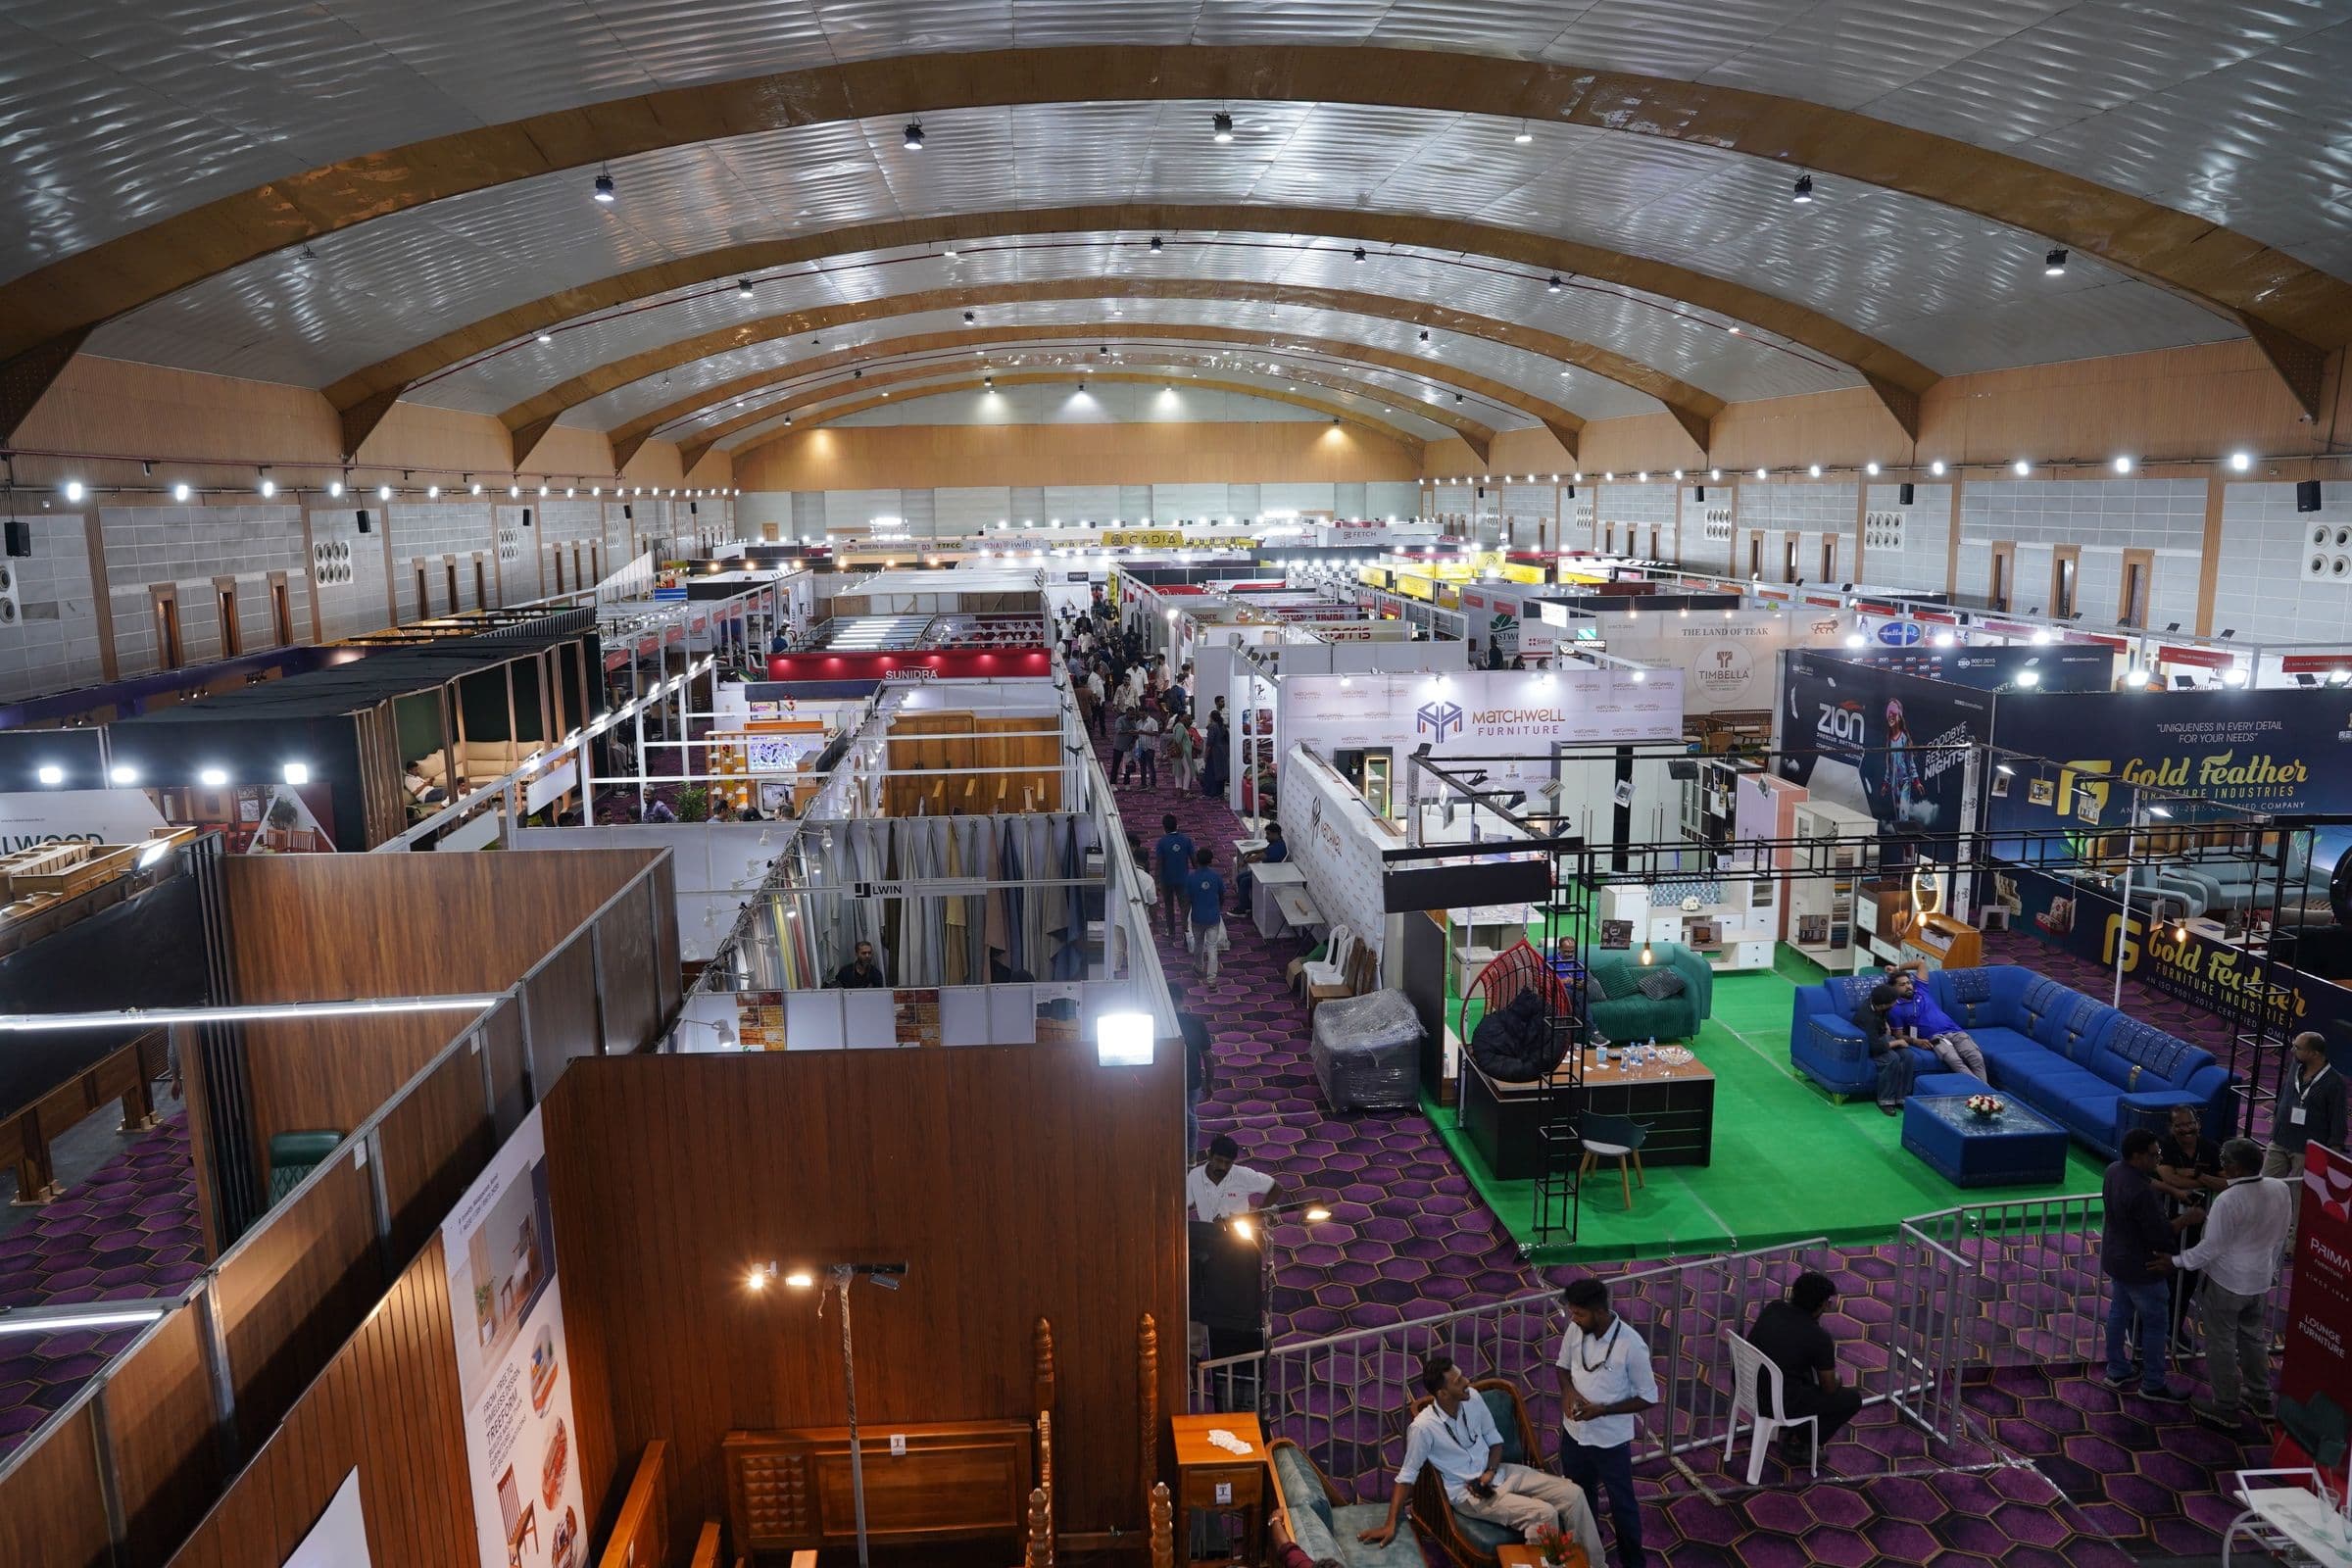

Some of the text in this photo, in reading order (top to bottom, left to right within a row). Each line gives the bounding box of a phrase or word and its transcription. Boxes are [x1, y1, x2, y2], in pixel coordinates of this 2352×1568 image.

[1129, 534, 1176, 544] CADIA
[1682, 628, 1700, 637] THE
[886, 669, 938, 680] SUNIDRA
[1698, 670, 1748, 680] TIMBELLA
[1478, 725, 1559, 736] FURNITURE
[2157, 720, 2282, 733] "UNIQUENESS IN EVERY DETAIL
[2227, 733, 2258, 742] NEEDS"
[1924, 750, 1966, 780] NIGHTS
[2122, 749, 2309, 786] Gold Feather
[2214, 785, 2294, 799] INDUSTRIES
[2260, 801, 2305, 809] COMPANY
[2148, 930, 2203, 974] Gold
[2156, 963, 2215, 996] FURNITURE
[2310, 1237, 2351, 1273] PRIMA
[2298, 1321, 2345, 1359] FURNITURE
[2305, 1314, 2341, 1345] LOUNGE
[483, 1390, 497, 1415] FROM
[496, 1372, 508, 1392] TREE
[486, 1387, 517, 1446] TREEFORM
